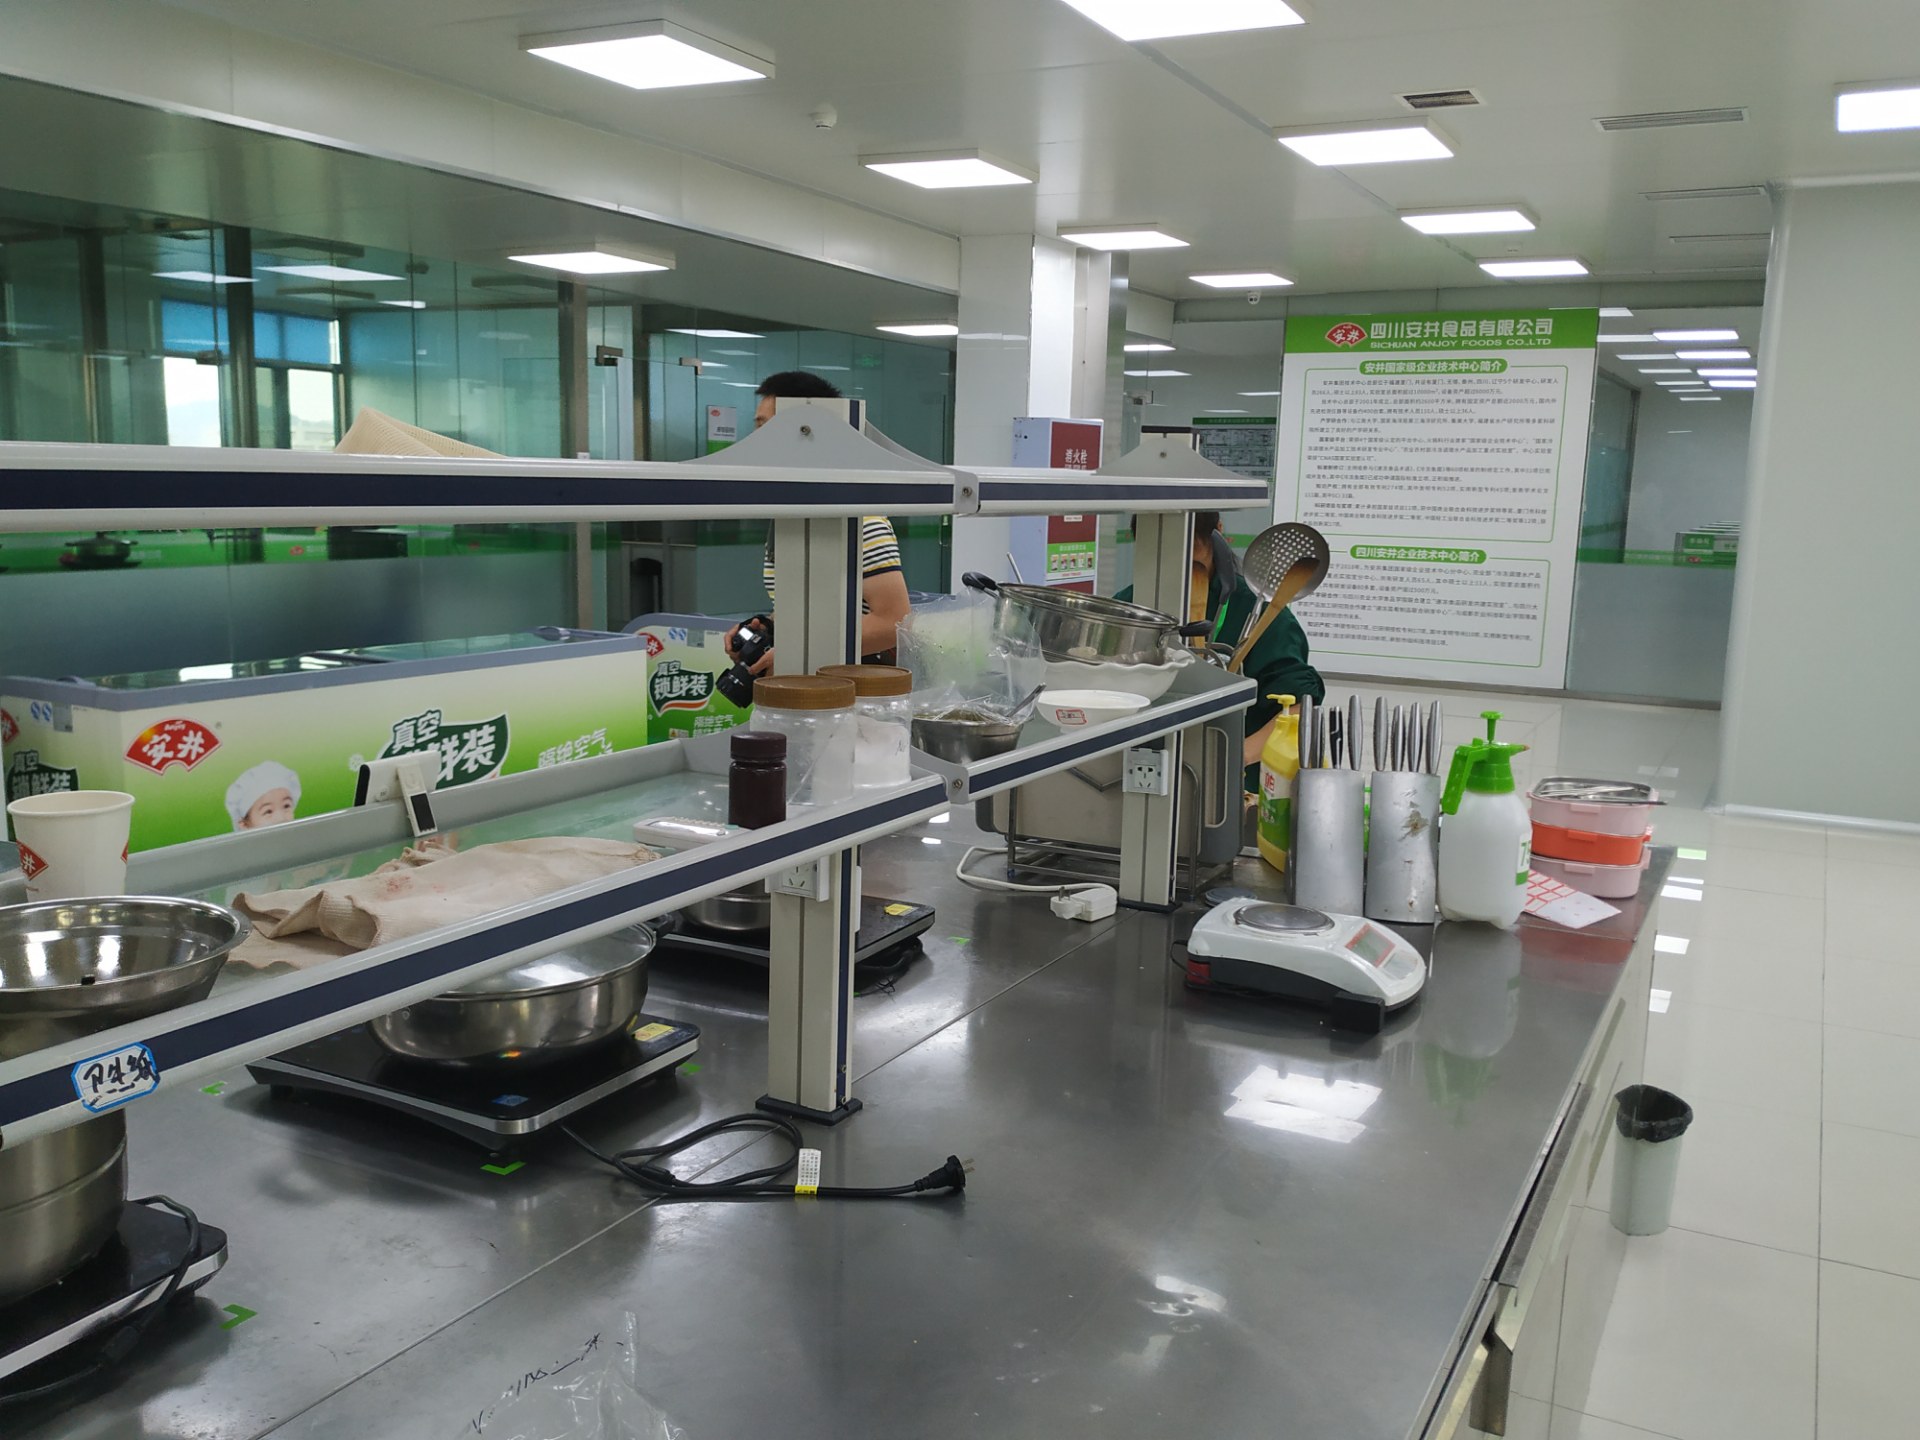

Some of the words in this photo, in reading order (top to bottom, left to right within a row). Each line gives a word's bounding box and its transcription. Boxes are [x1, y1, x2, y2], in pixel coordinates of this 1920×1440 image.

[1332, 328, 1360, 344] 安井
[1371, 318, 1553, 339] 四川安井食品有限公司
[1371, 341, 1417, 349] SICHUAN
[1420, 340, 1457, 348] ANJOY
[1461, 339, 1502, 347] FOODS
[1364, 361, 1503, 374] 安井国家级企业技术中心简介
[1355, 547, 1480, 562] 四川安井企业技术中心简介
[657, 661, 680, 677] 真空
[654, 674, 708, 701] 锁鲜装
[392, 710, 441, 753] 真空
[141, 729, 206, 767] 安井
